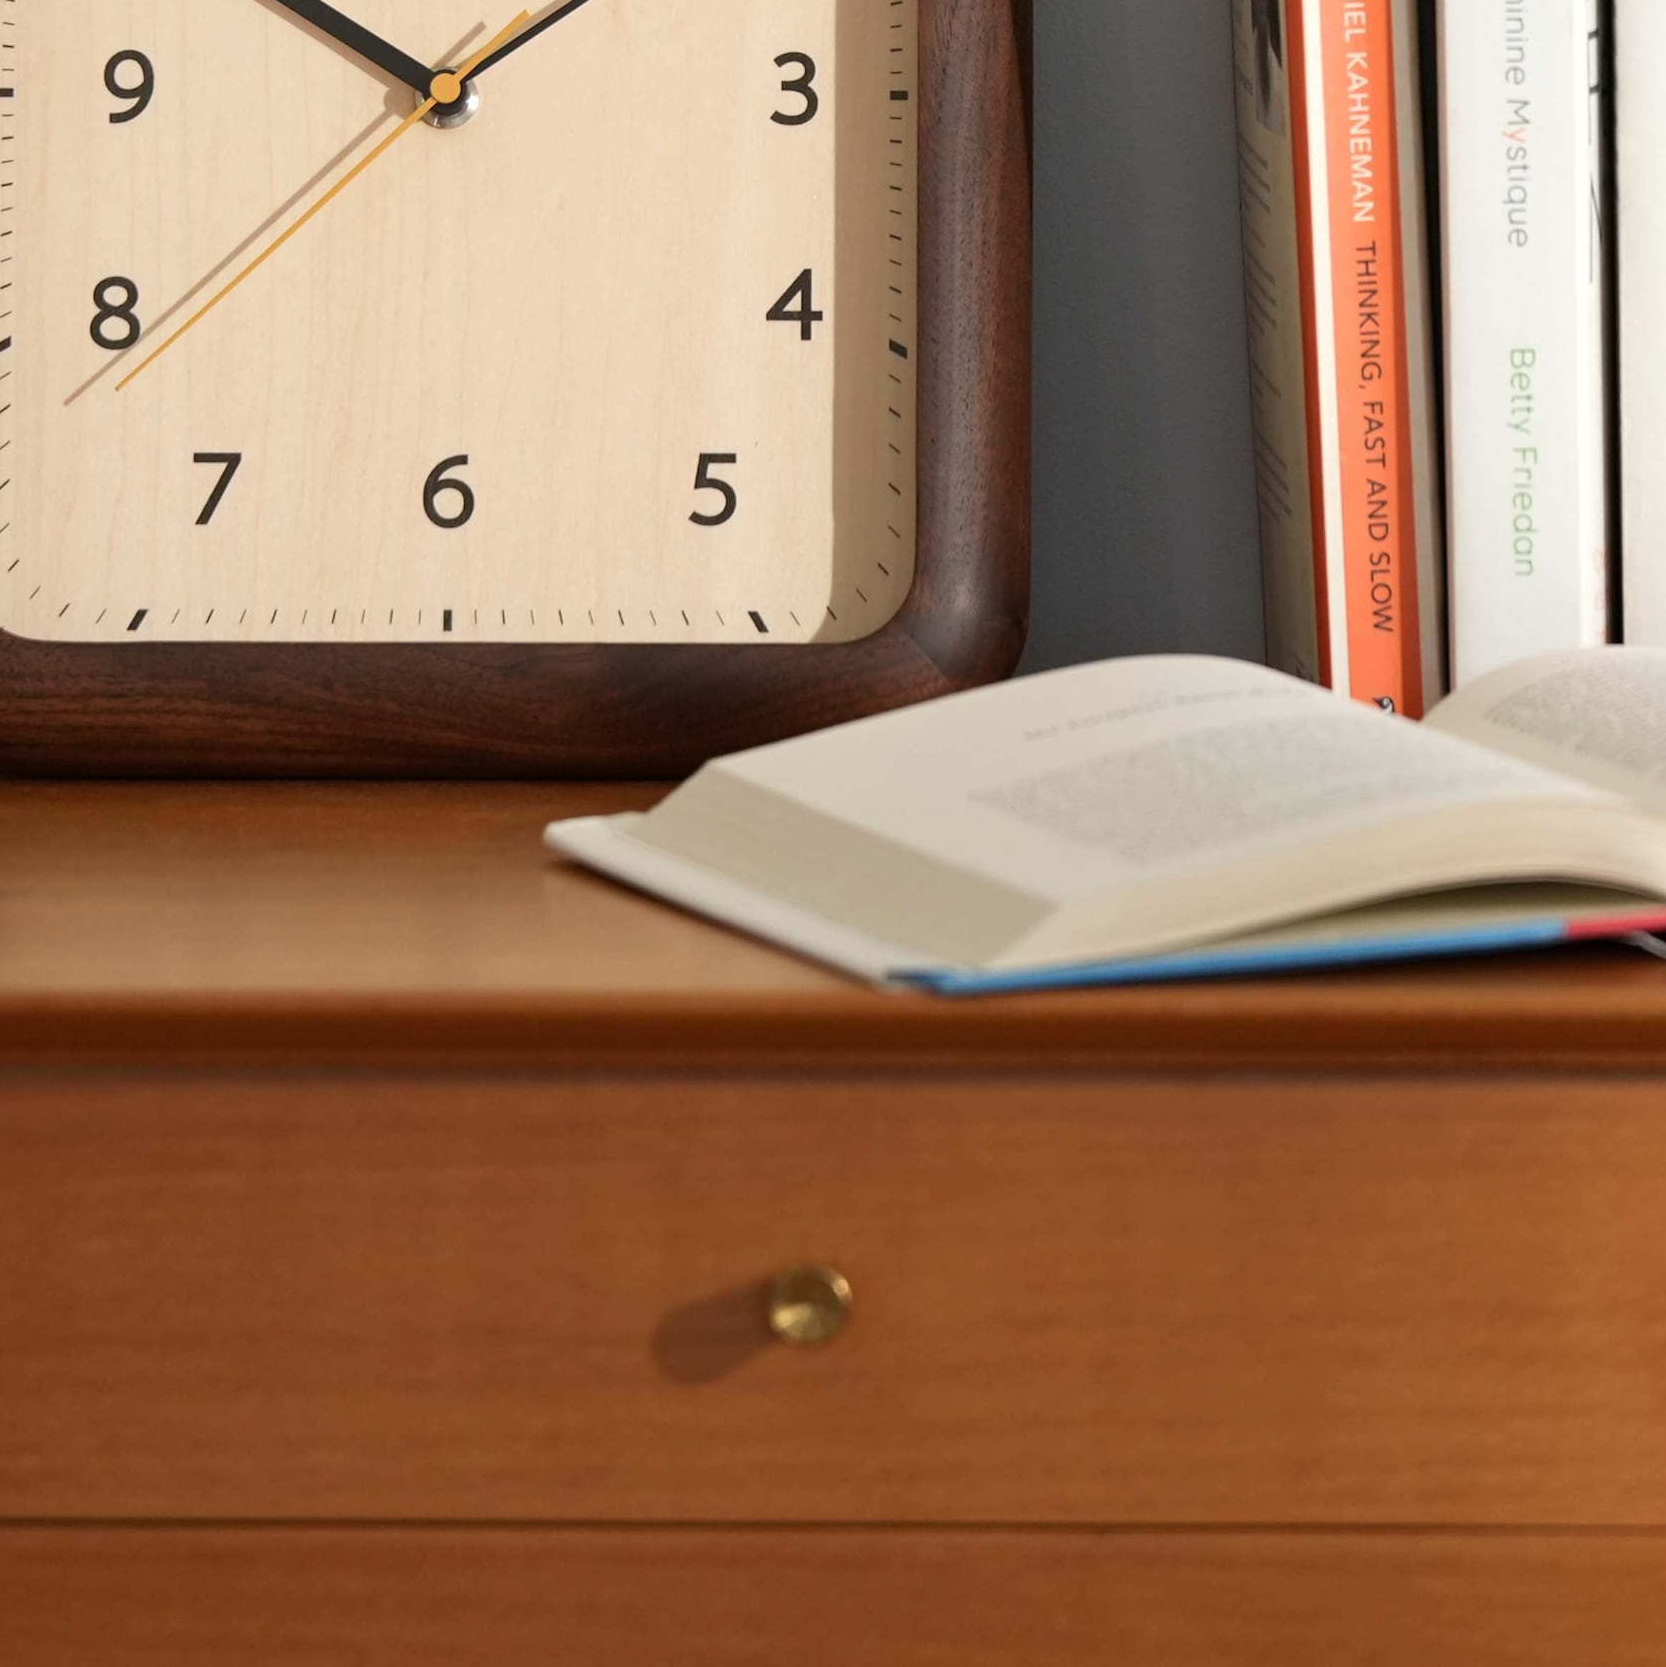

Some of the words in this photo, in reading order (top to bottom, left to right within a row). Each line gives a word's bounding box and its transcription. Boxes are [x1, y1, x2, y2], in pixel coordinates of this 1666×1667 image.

[103, 49, 155, 124] 9
[769, 51, 819, 126] 3
[1346, 51, 1376, 223] KAHNEMAN
[1502, 99, 1531, 248] Mystique
[89, 275, 141, 351] 8
[765, 268, 824, 341] 4
[1356, 239, 1383, 390] THINKING,
[1507, 348, 1536, 433] Betty
[1363, 400, 1387, 470] FAST
[192, 452, 242, 526] 7
[422, 454, 475, 529] 6
[688, 452, 737, 527] 5
[1366, 478, 1389, 542] AND
[1512, 447, 1538, 577] Friedan
[1369, 551, 1394, 633] SLOW
